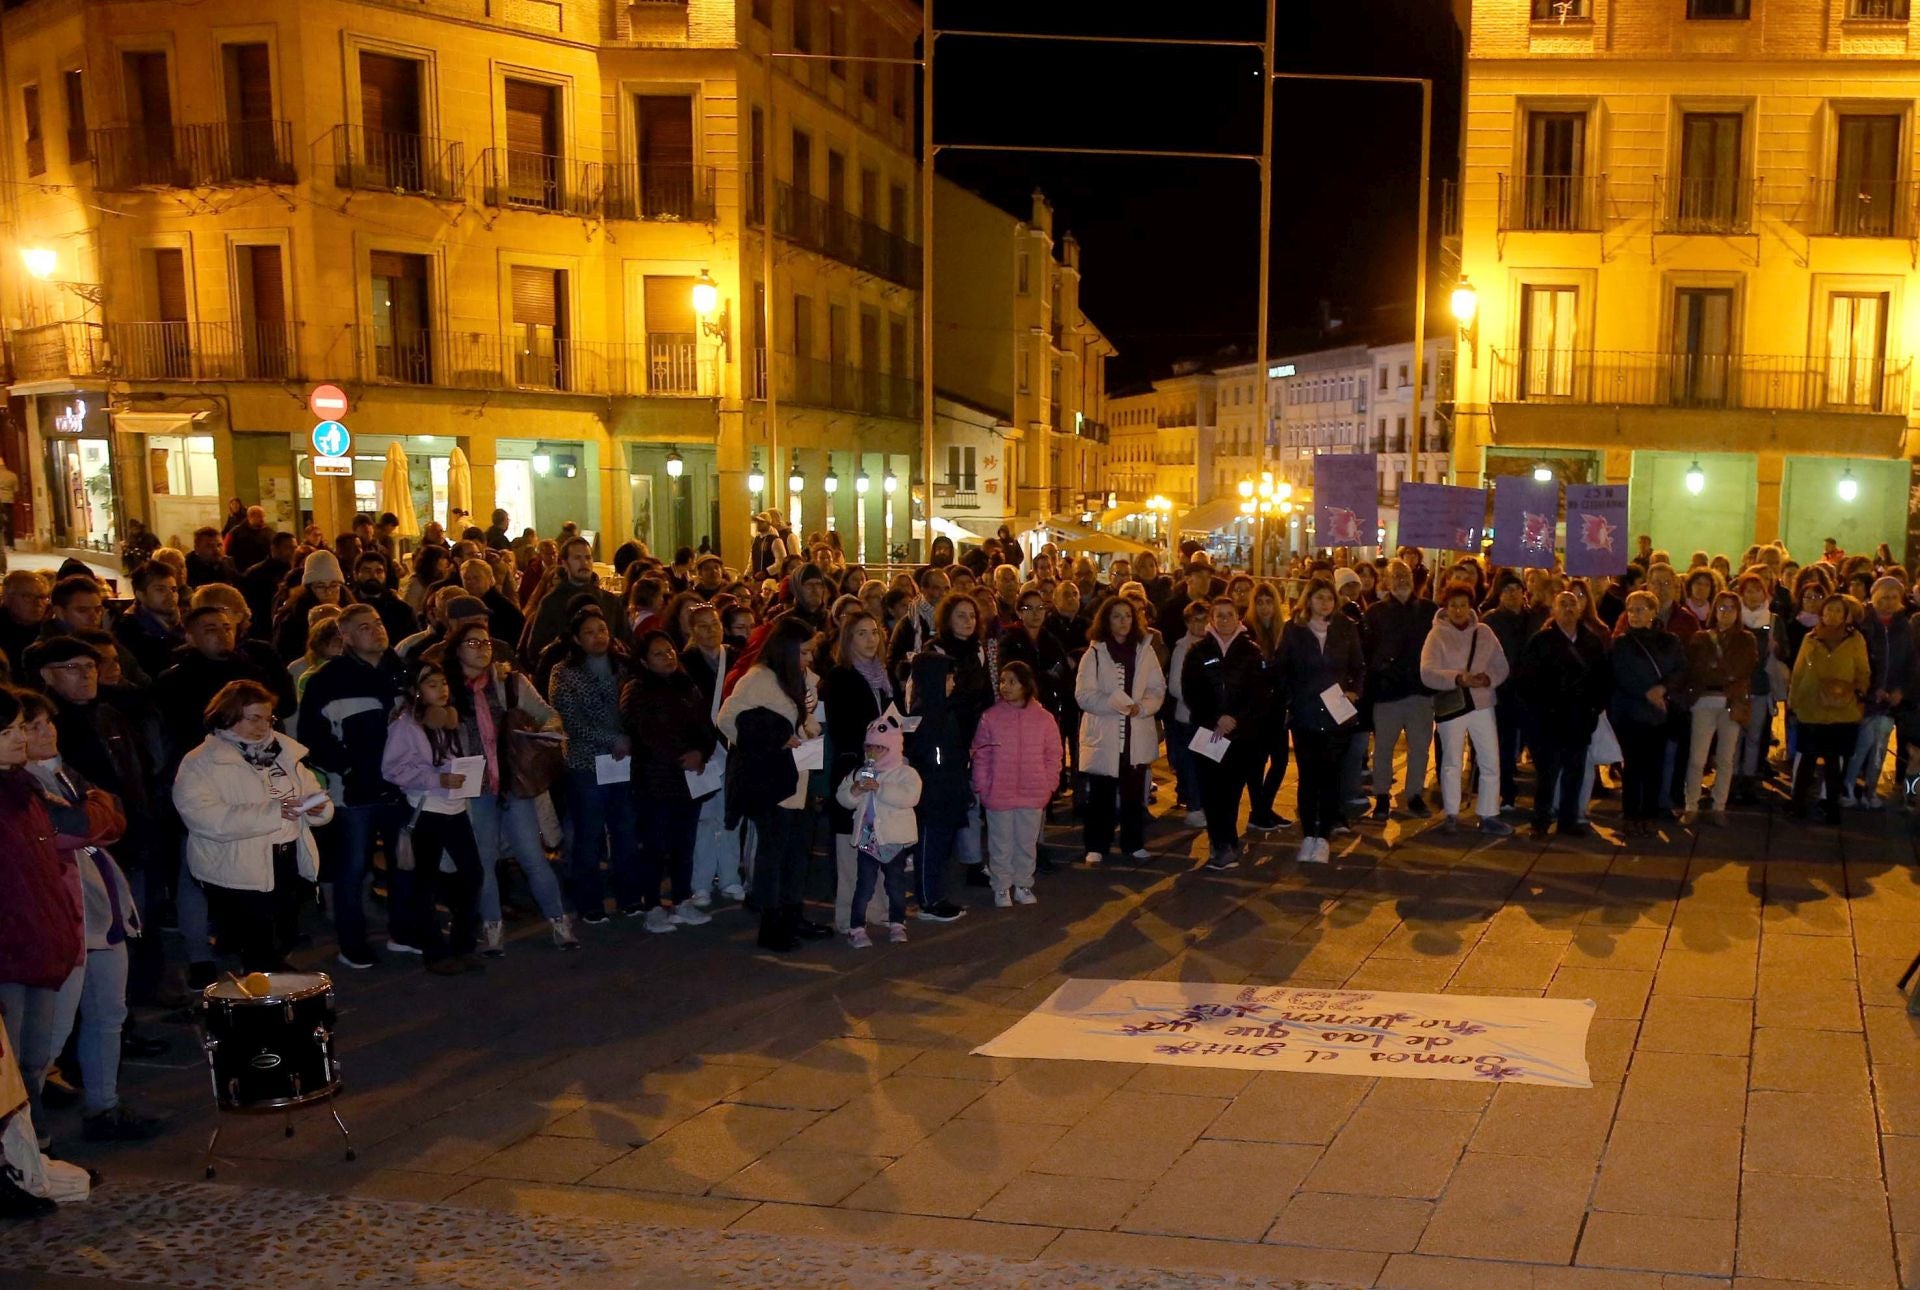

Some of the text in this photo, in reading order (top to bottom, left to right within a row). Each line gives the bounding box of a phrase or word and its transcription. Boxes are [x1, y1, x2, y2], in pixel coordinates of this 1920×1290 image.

[1224, 1021, 1291, 1040] que
[1412, 1018, 1469, 1032] no
[1320, 1032, 1385, 1049] las
[1404, 1034, 1454, 1052] de
[1181, 1041, 1507, 1074] Somos el grito
